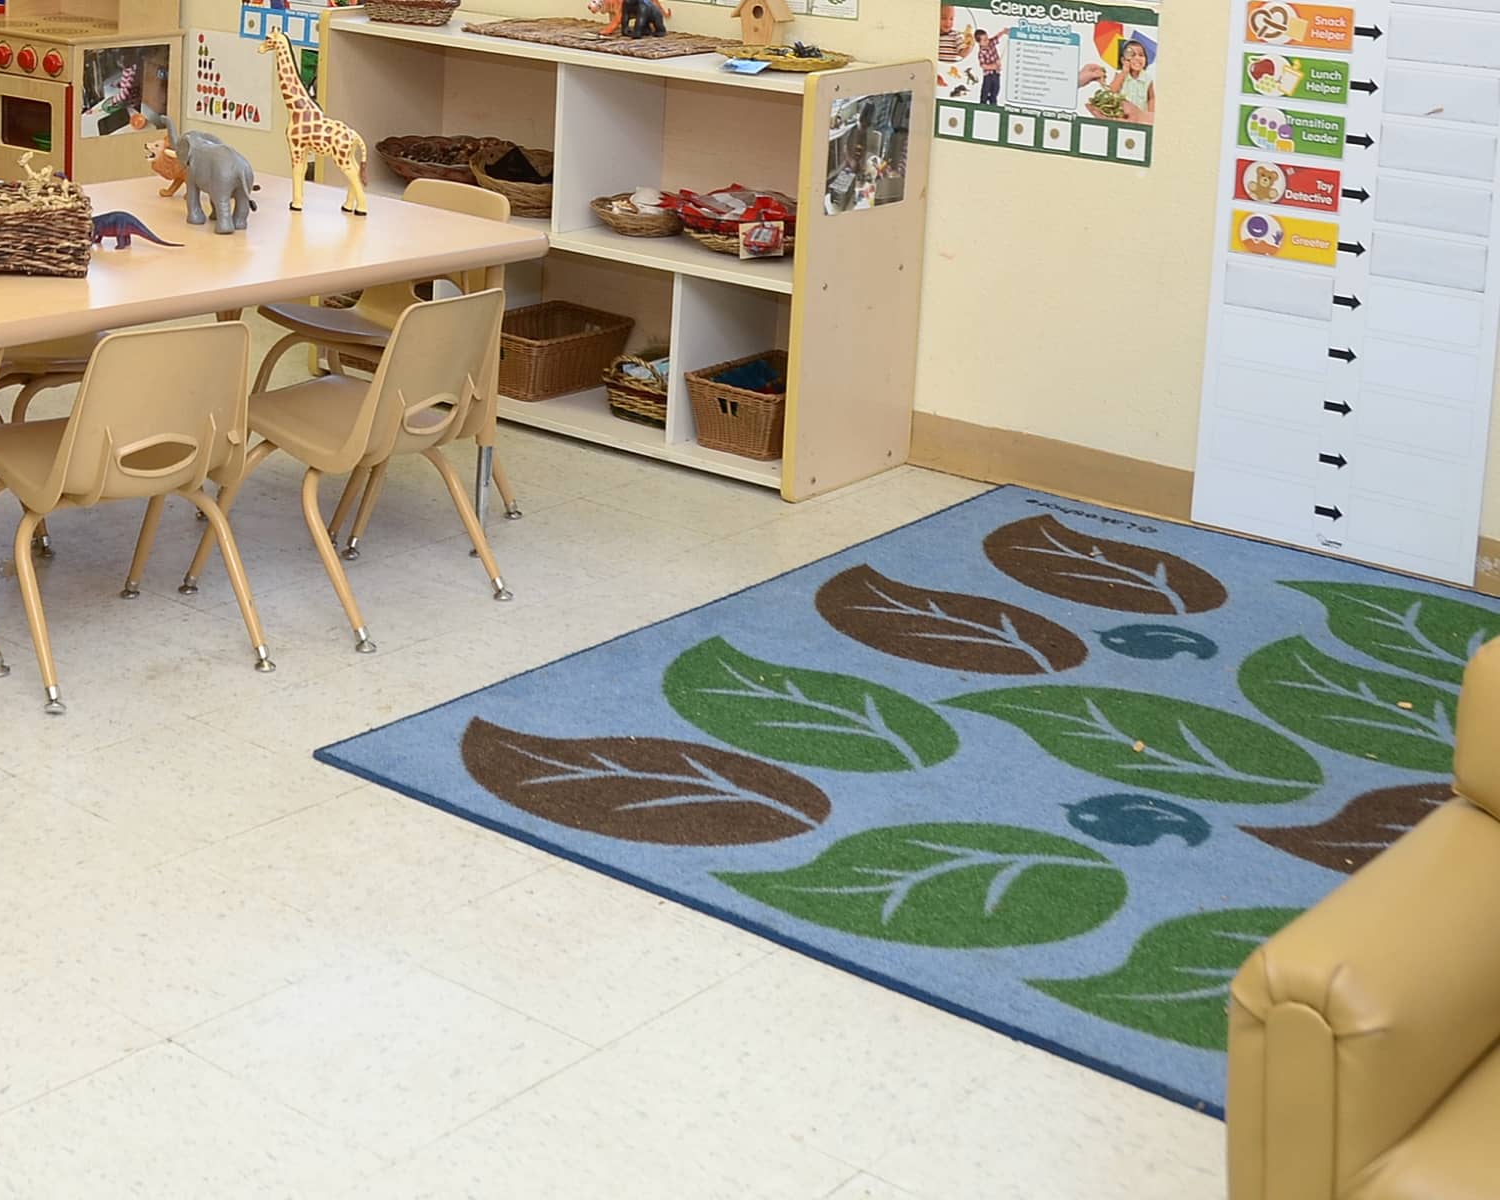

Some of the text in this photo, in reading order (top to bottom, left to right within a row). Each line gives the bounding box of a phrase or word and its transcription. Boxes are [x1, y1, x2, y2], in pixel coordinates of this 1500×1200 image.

[1049, 4, 1102, 23] Center
[1018, 18, 1072, 35] Preschool
[1314, 15, 1347, 28] Snack
[1310, 28, 1347, 43] Helper
[1310, 68, 1342, 81] Lunch
[1306, 81, 1342, 96] Helper
[1286, 114, 1339, 131] Transition
[1301, 131, 1338, 146] Leader
[1315, 180, 1335, 194] Toy
[1284, 189, 1333, 205] Detective
[1290, 234, 1331, 250] Greeter
